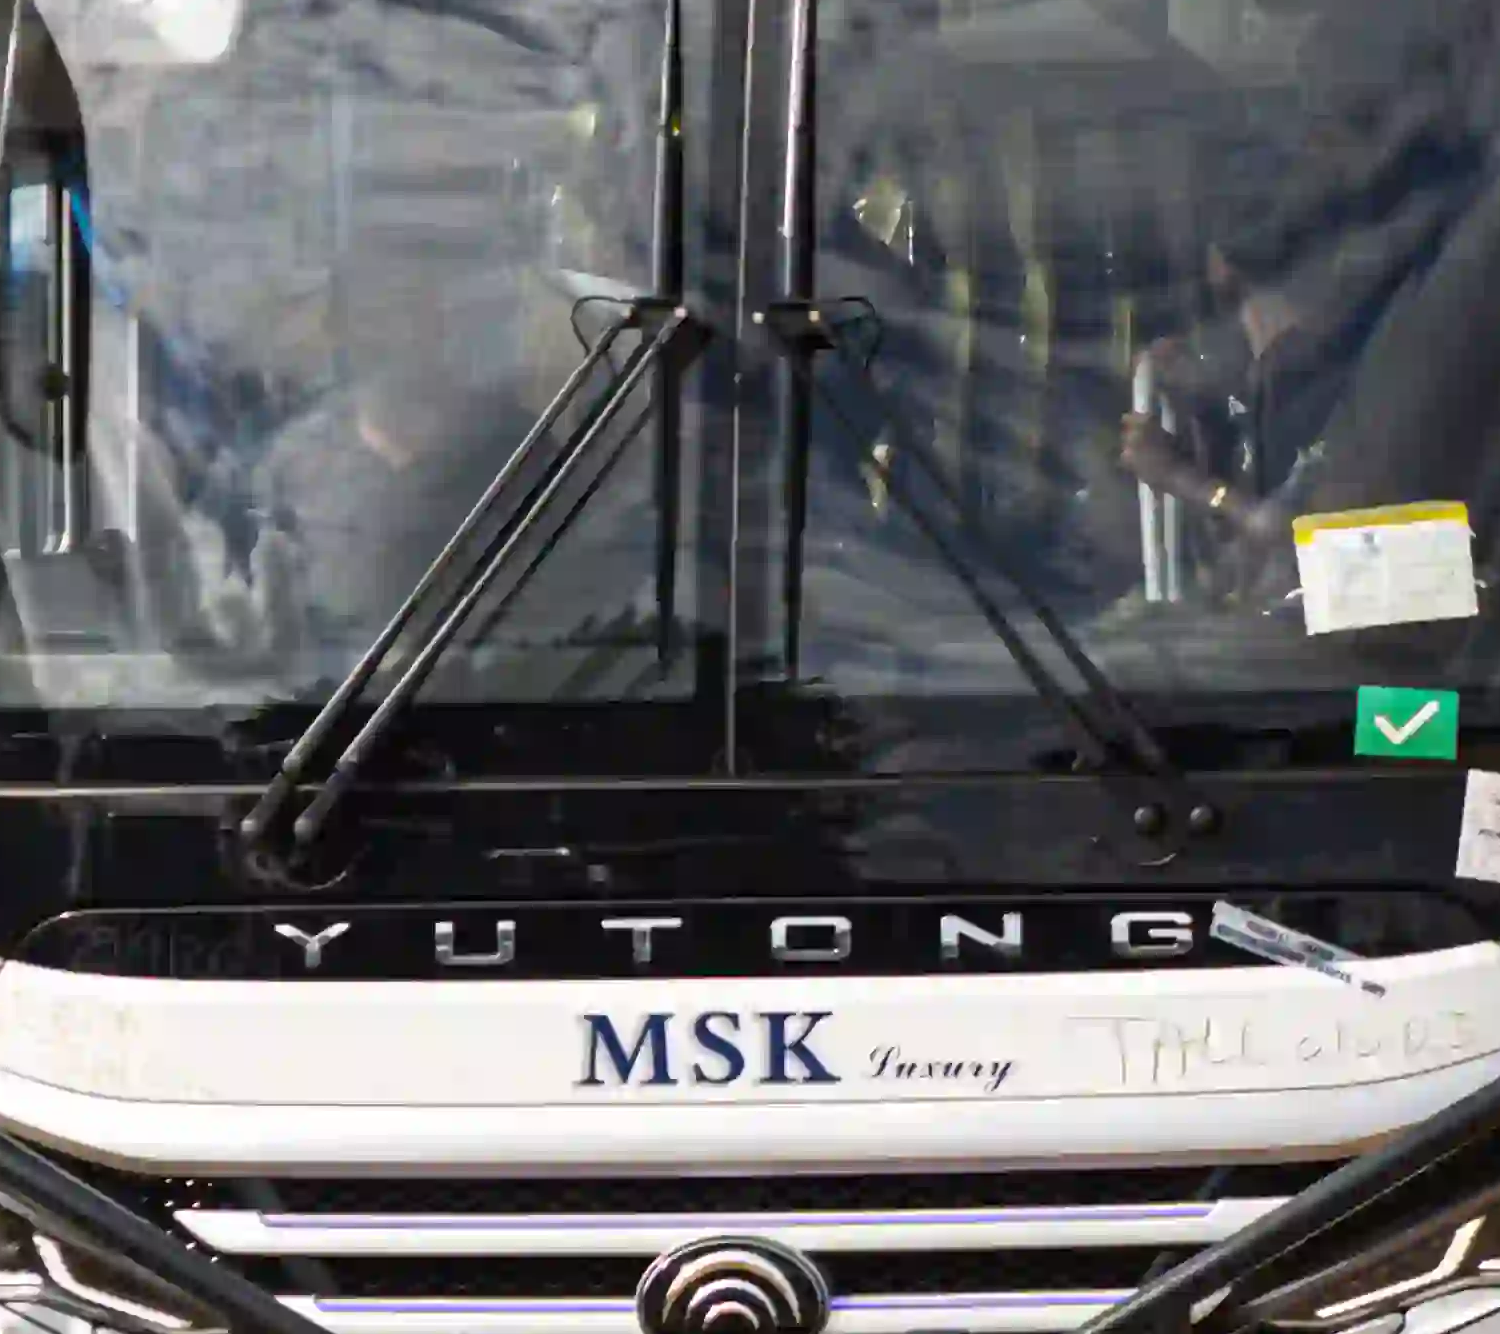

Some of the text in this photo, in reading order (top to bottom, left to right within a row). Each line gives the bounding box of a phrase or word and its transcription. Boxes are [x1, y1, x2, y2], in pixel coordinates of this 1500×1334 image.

[275, 912, 1194, 967] YUTONG
[572, 1010, 1017, 1092] MSK Luxury
